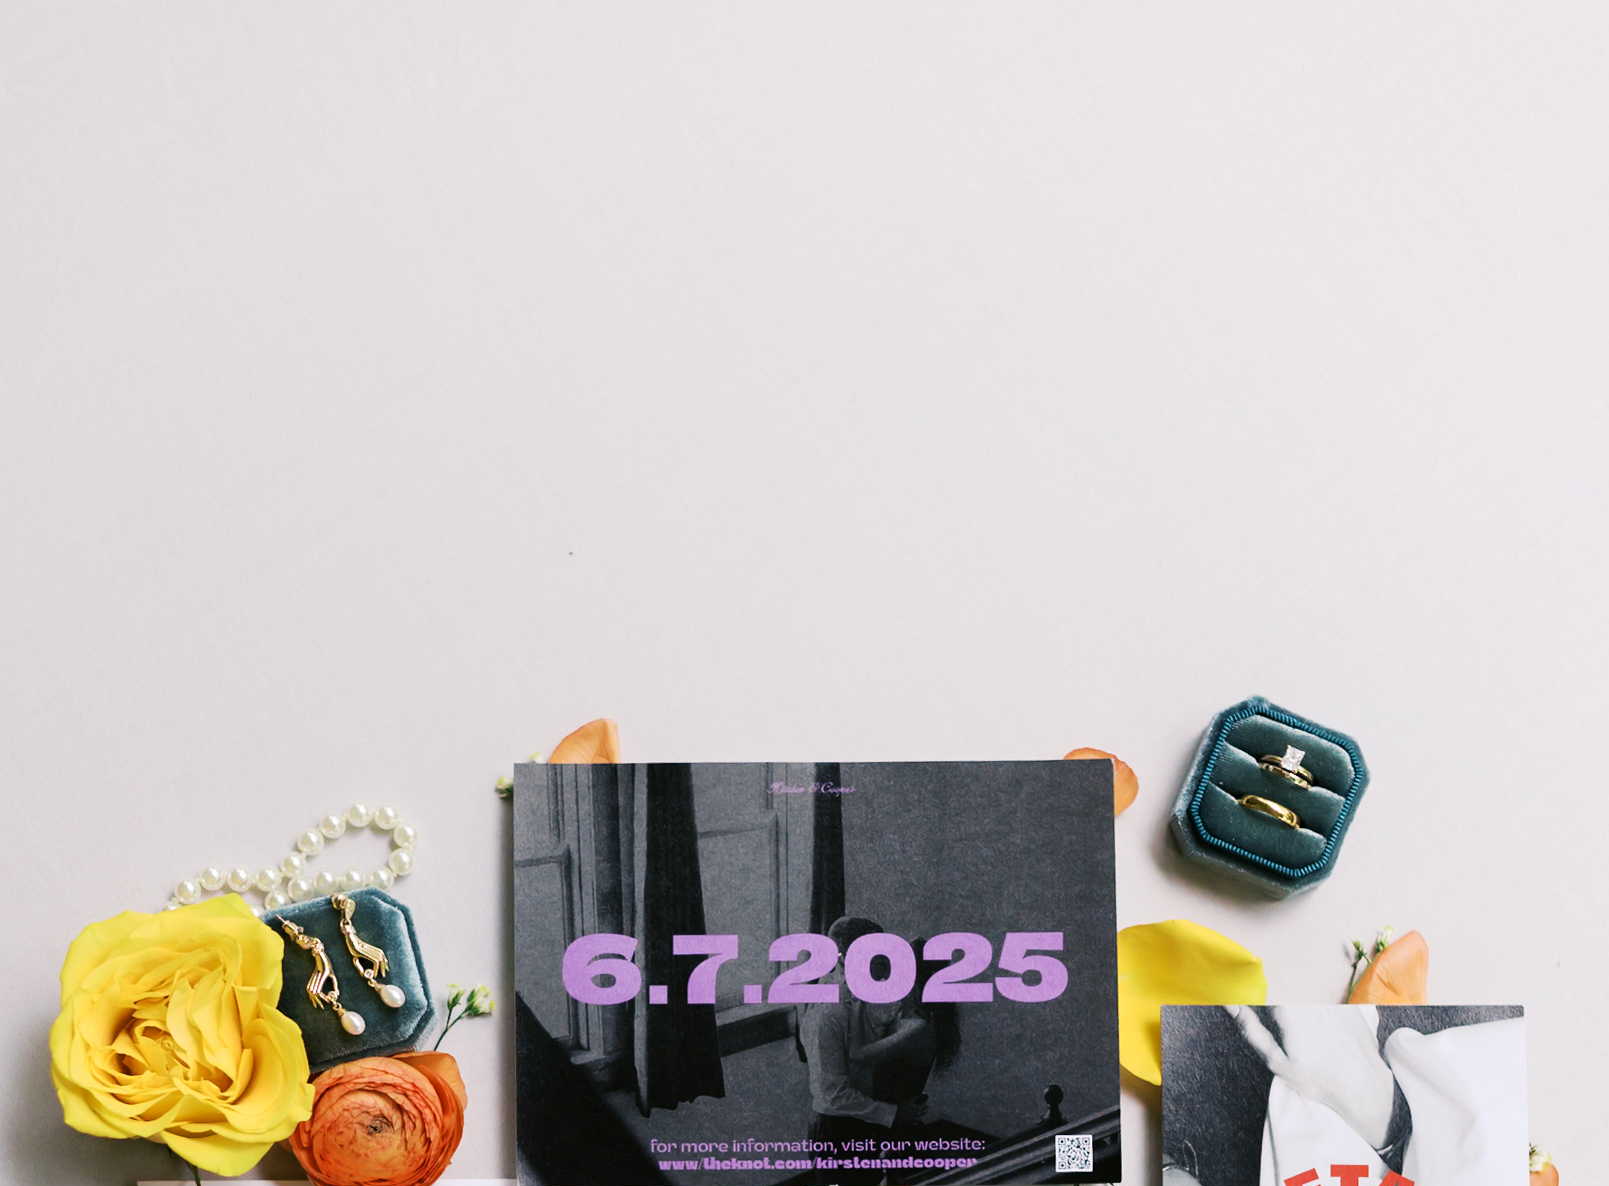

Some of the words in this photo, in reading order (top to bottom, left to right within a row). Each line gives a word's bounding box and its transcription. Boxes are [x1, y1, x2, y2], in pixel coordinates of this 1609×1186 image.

[562, 932, 1069, 1005] 6.7.2025
[650, 1138, 677, 1153] for
[681, 1142, 728, 1152] more
[732, 1138, 837, 1154] information,
[842, 1138, 876, 1151] visit
[880, 1140, 911, 1151] our
[915, 1138, 985, 1150] website:
